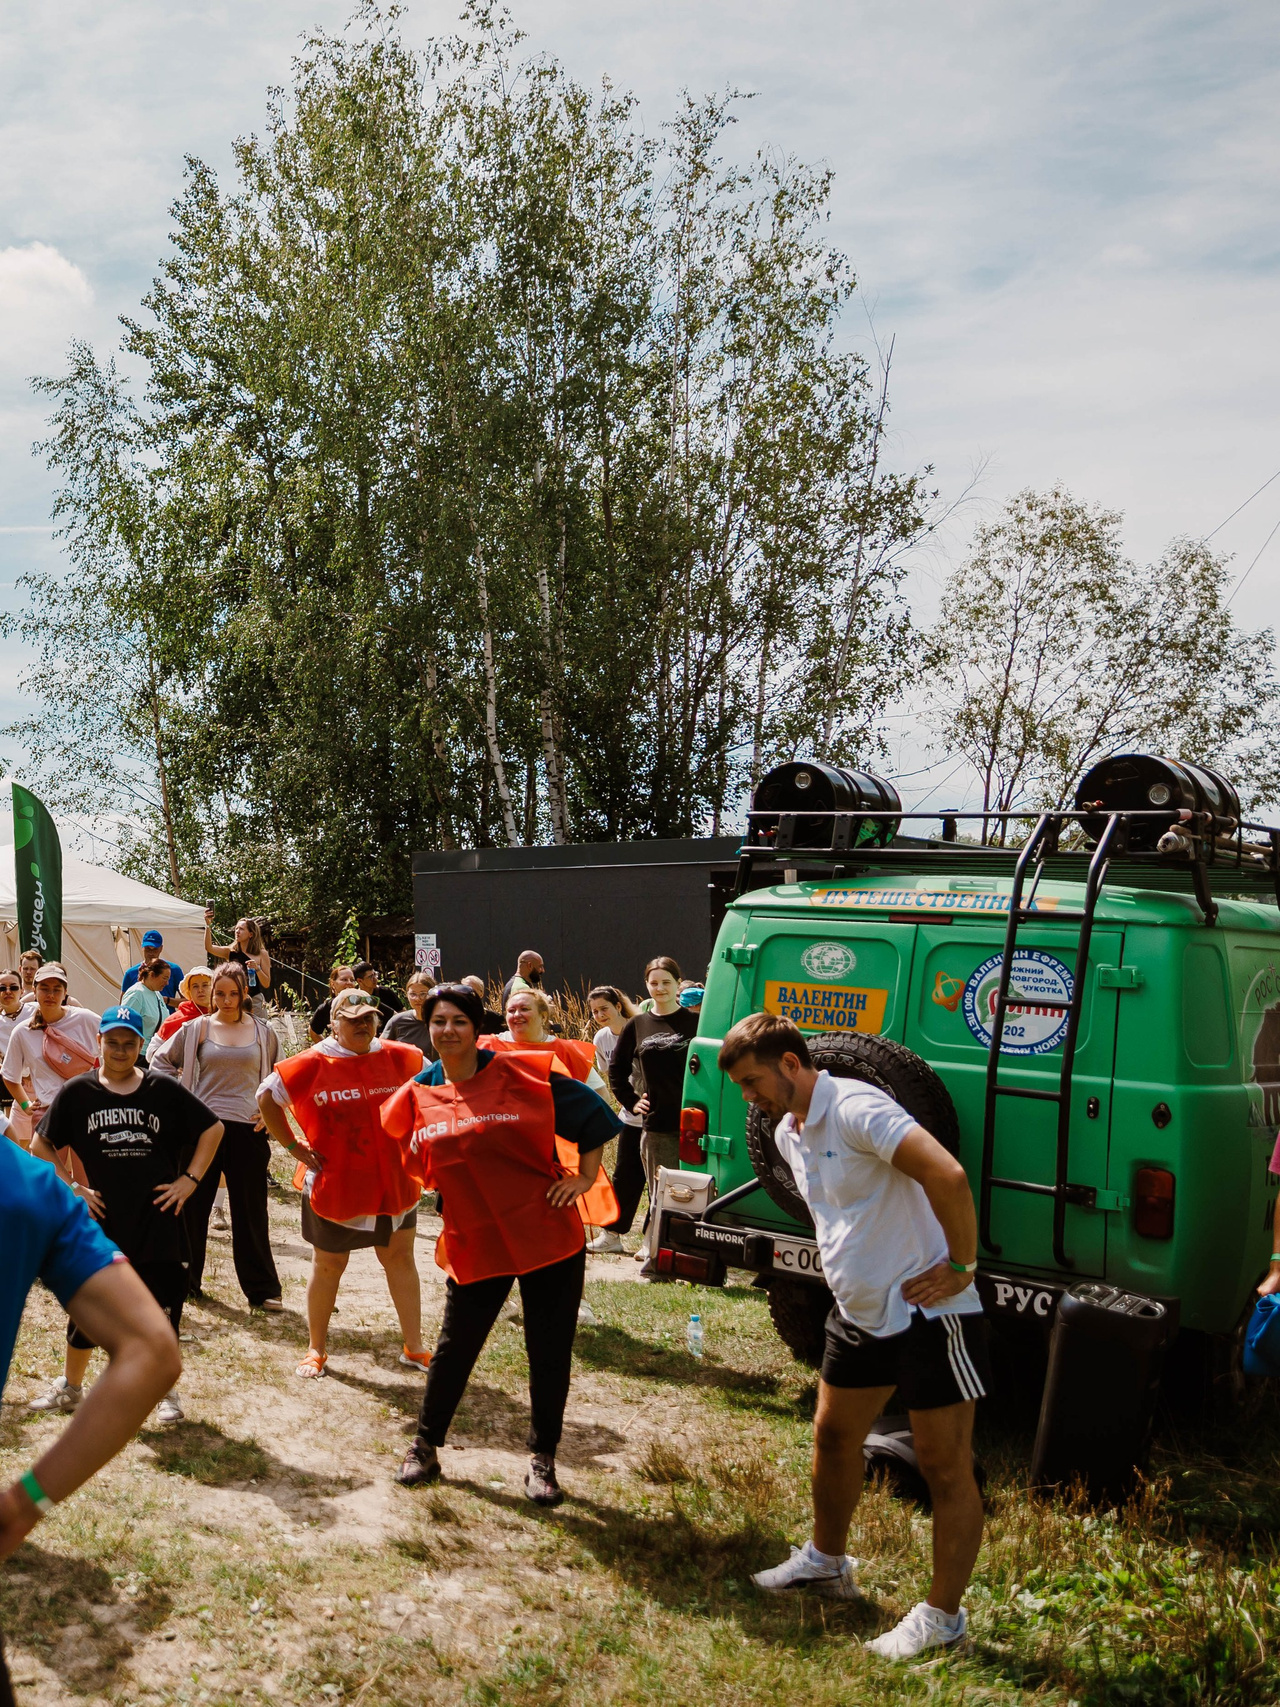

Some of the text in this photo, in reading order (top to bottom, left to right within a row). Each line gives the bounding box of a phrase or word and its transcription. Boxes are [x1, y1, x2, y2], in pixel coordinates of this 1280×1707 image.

[969, 950, 1029, 987] ВАЛЕНИН
[1010, 966, 1044, 975] ИЖНИЙ
[777, 986, 868, 1011] ВАЛЕНТИН
[1022, 984, 1063, 995] ЧУКОТКА
[964, 992, 974, 1011] 800
[781, 1005, 858, 1028] ЕФРЕМОВ
[966, 1012, 981, 1032] ЛЕТ
[331, 1088, 361, 1102] ПСБ
[87, 1107, 145, 1134] AUTHENTIC
[418, 1112, 520, 1142] ПСБ волонтеры
[994, 1282, 1053, 1316] РУС
